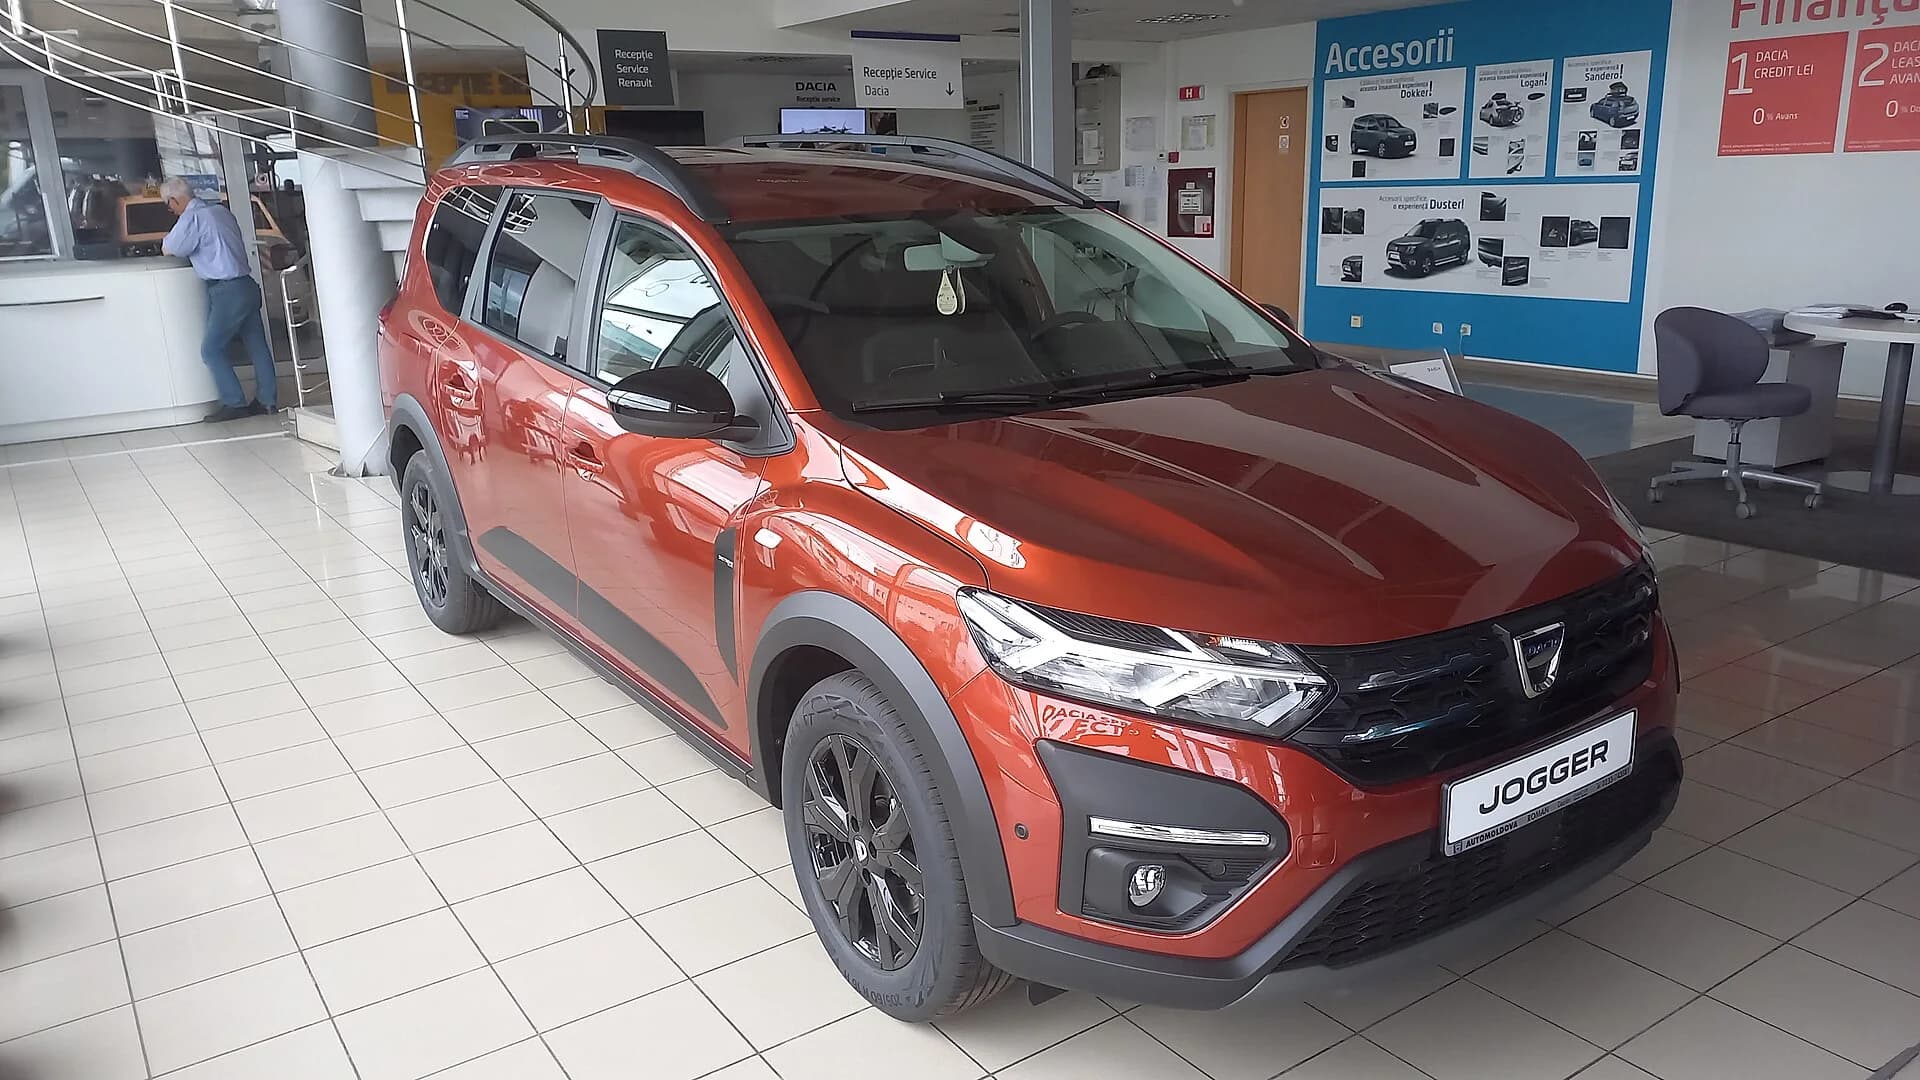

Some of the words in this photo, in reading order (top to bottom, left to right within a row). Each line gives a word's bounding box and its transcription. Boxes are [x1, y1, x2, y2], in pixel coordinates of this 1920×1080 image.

[1325, 28, 1454, 75] Accesorii
[616, 64, 649, 74] Service
[863, 66, 902, 80] Recepție
[905, 68, 937, 79] Service
[1585, 63, 1623, 82] Sandero!
[1728, 52, 1753, 95] 1
[1756, 49, 1789, 63] DACIA
[1754, 66, 1794, 79] CREDIT
[1797, 64, 1814, 76] LEI
[1858, 42, 1889, 87] 2
[618, 78, 653, 88] Renault
[795, 81, 837, 92] DACIA
[1400, 80, 1433, 98] Dokker!
[1520, 72, 1548, 88] Logan!
[864, 85, 890, 96] Dacia
[1753, 107, 1765, 125] 0
[1775, 112, 1799, 121] Avans
[1886, 99, 1898, 118] 0
[1430, 199, 1465, 210] Duster!
[1479, 740, 1609, 815] JOGGER
[1465, 822, 1518, 849] AUTOMOLDOVA
